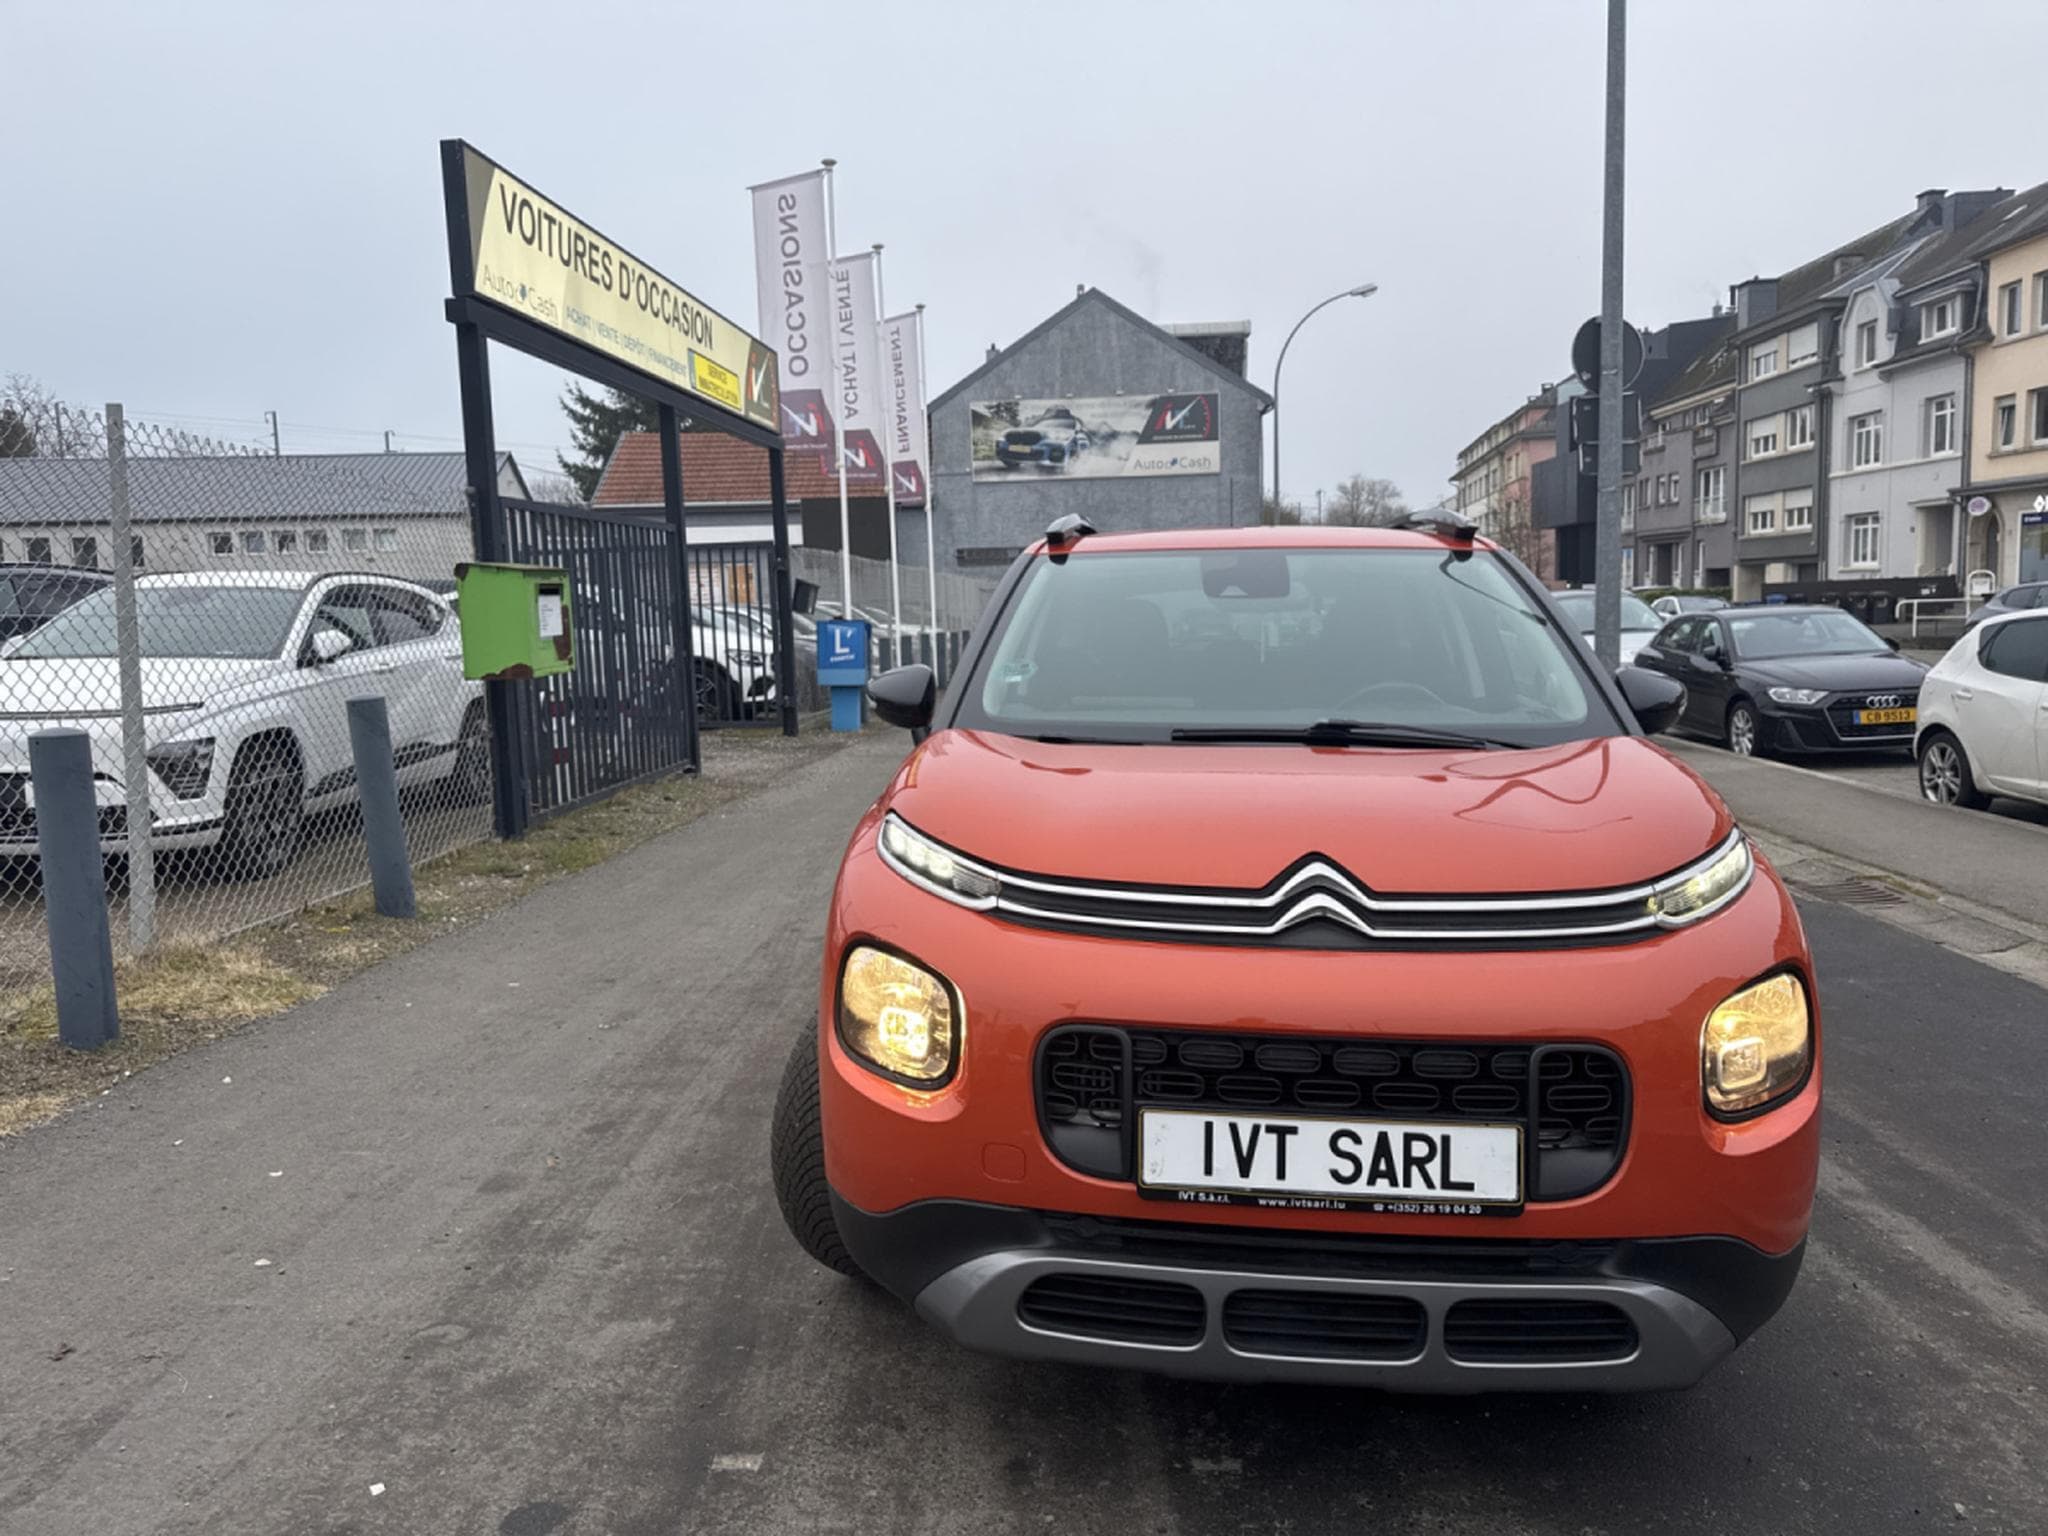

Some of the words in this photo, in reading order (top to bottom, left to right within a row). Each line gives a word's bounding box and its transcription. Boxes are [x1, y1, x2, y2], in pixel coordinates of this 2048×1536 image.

[500, 183, 612, 291] VOITURES
[619, 258, 713, 350] D'OCCASION
[1204, 1121, 1298, 1180] IVT
[1329, 1129, 1475, 1191] SARL
[1178, 1191, 1195, 1201] IVT
[1258, 1198, 1346, 1209] www.ivtsarl.lu
